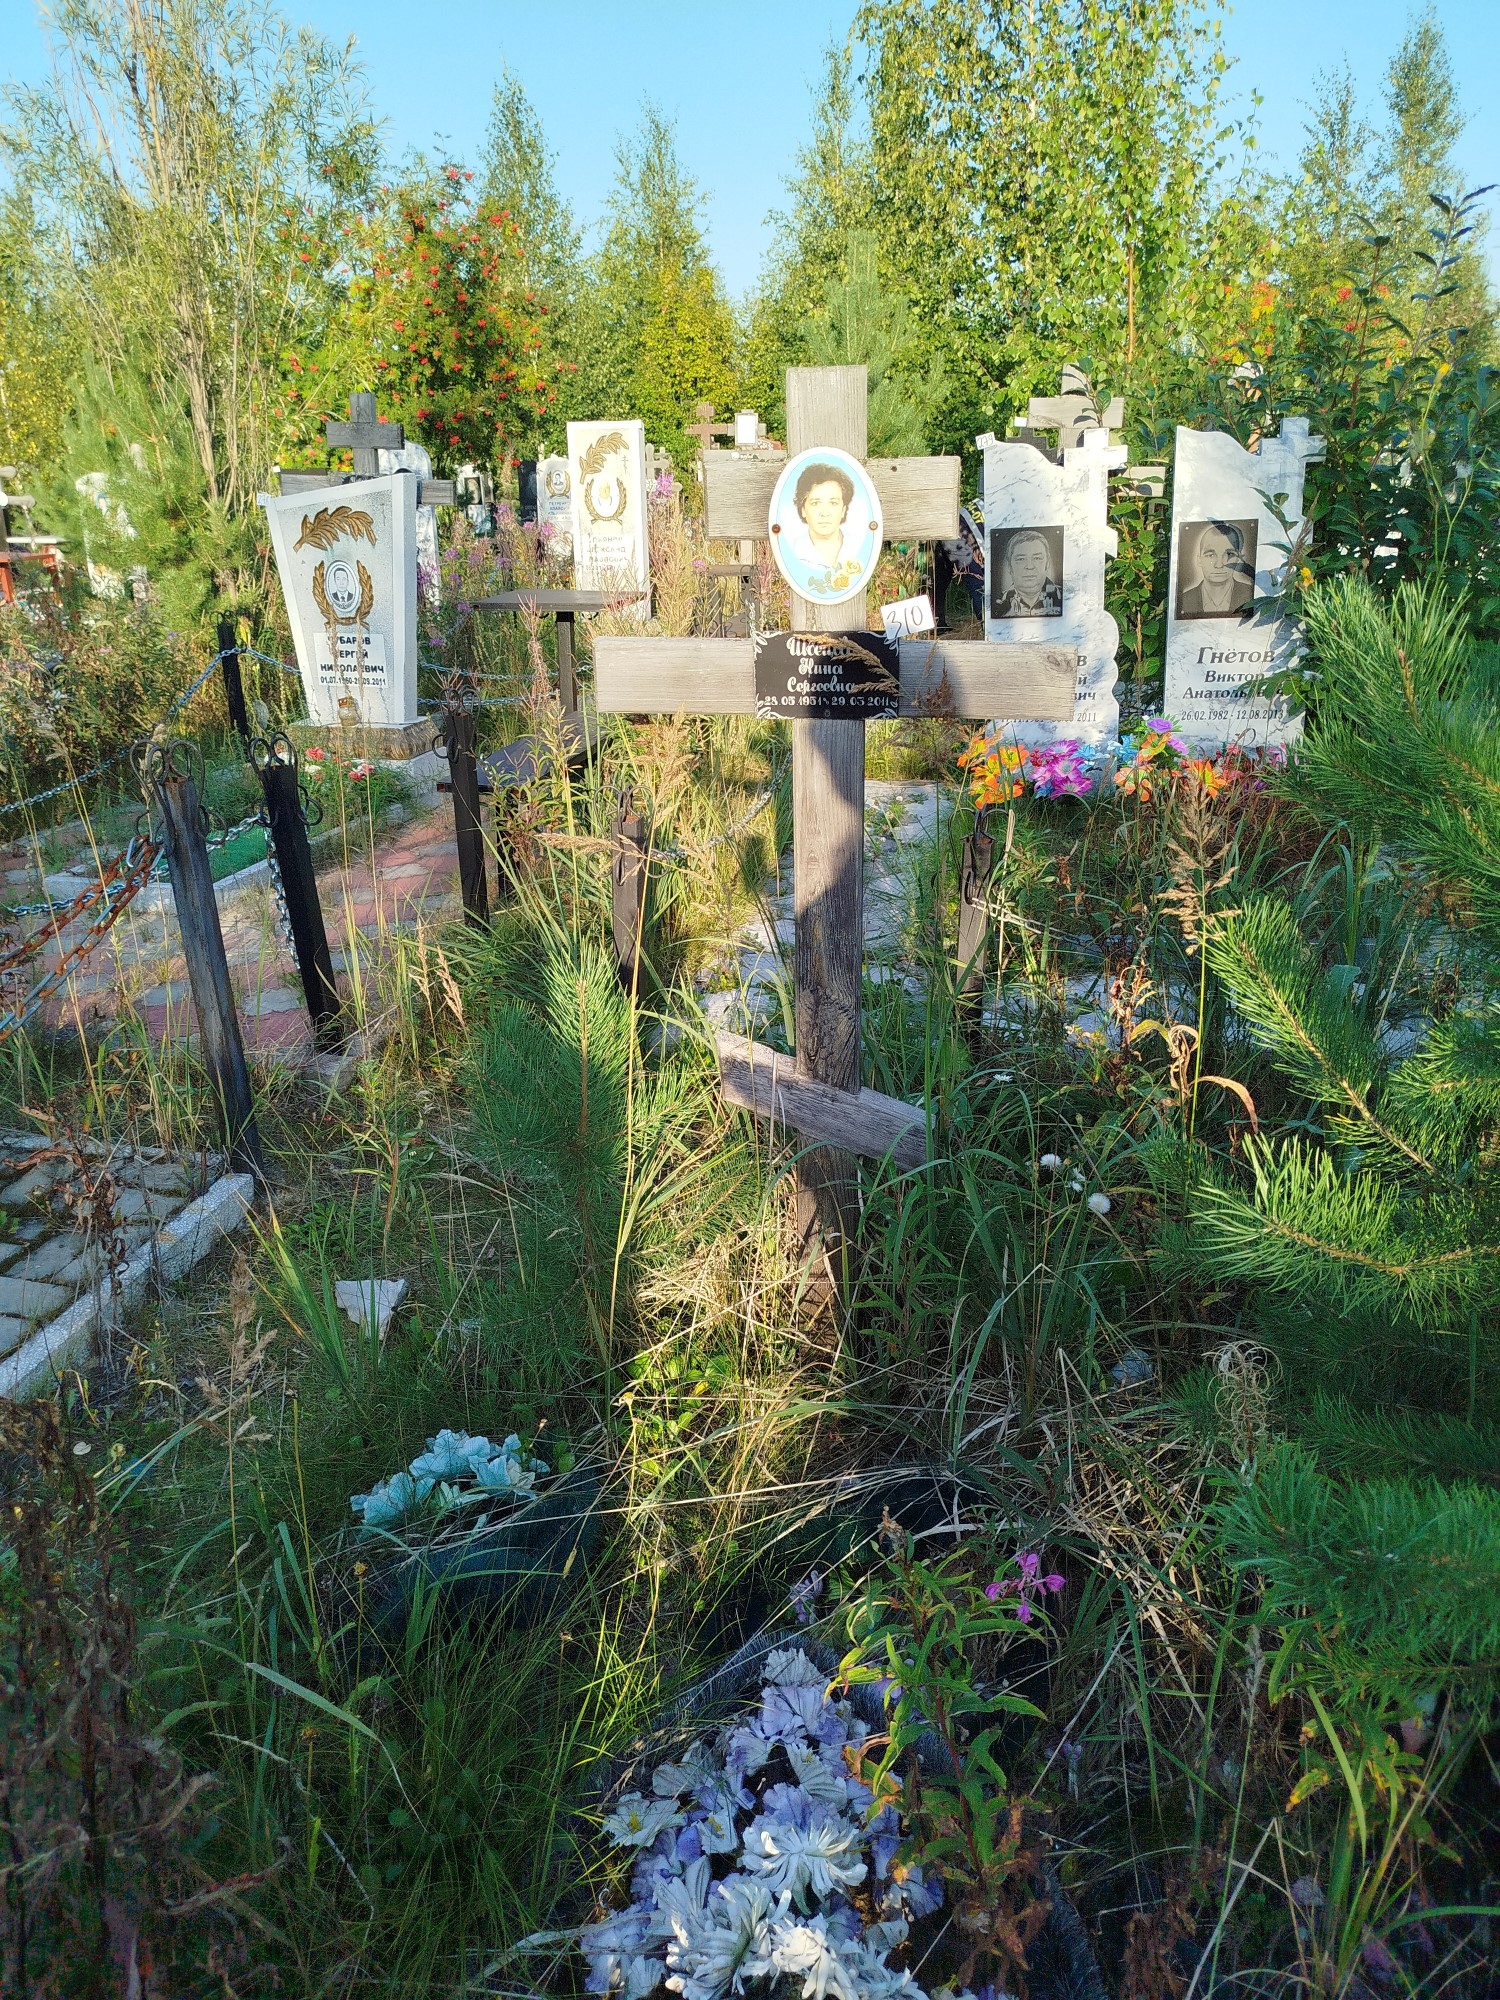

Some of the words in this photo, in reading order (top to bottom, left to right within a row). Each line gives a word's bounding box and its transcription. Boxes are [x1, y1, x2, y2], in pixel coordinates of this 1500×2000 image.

[886, 605, 924, 638] 310
[1197, 647, 1276, 664] Гнётов
[320, 663, 385, 673] НИОЛАВИЧ
[798, 657, 844, 678] Нина
